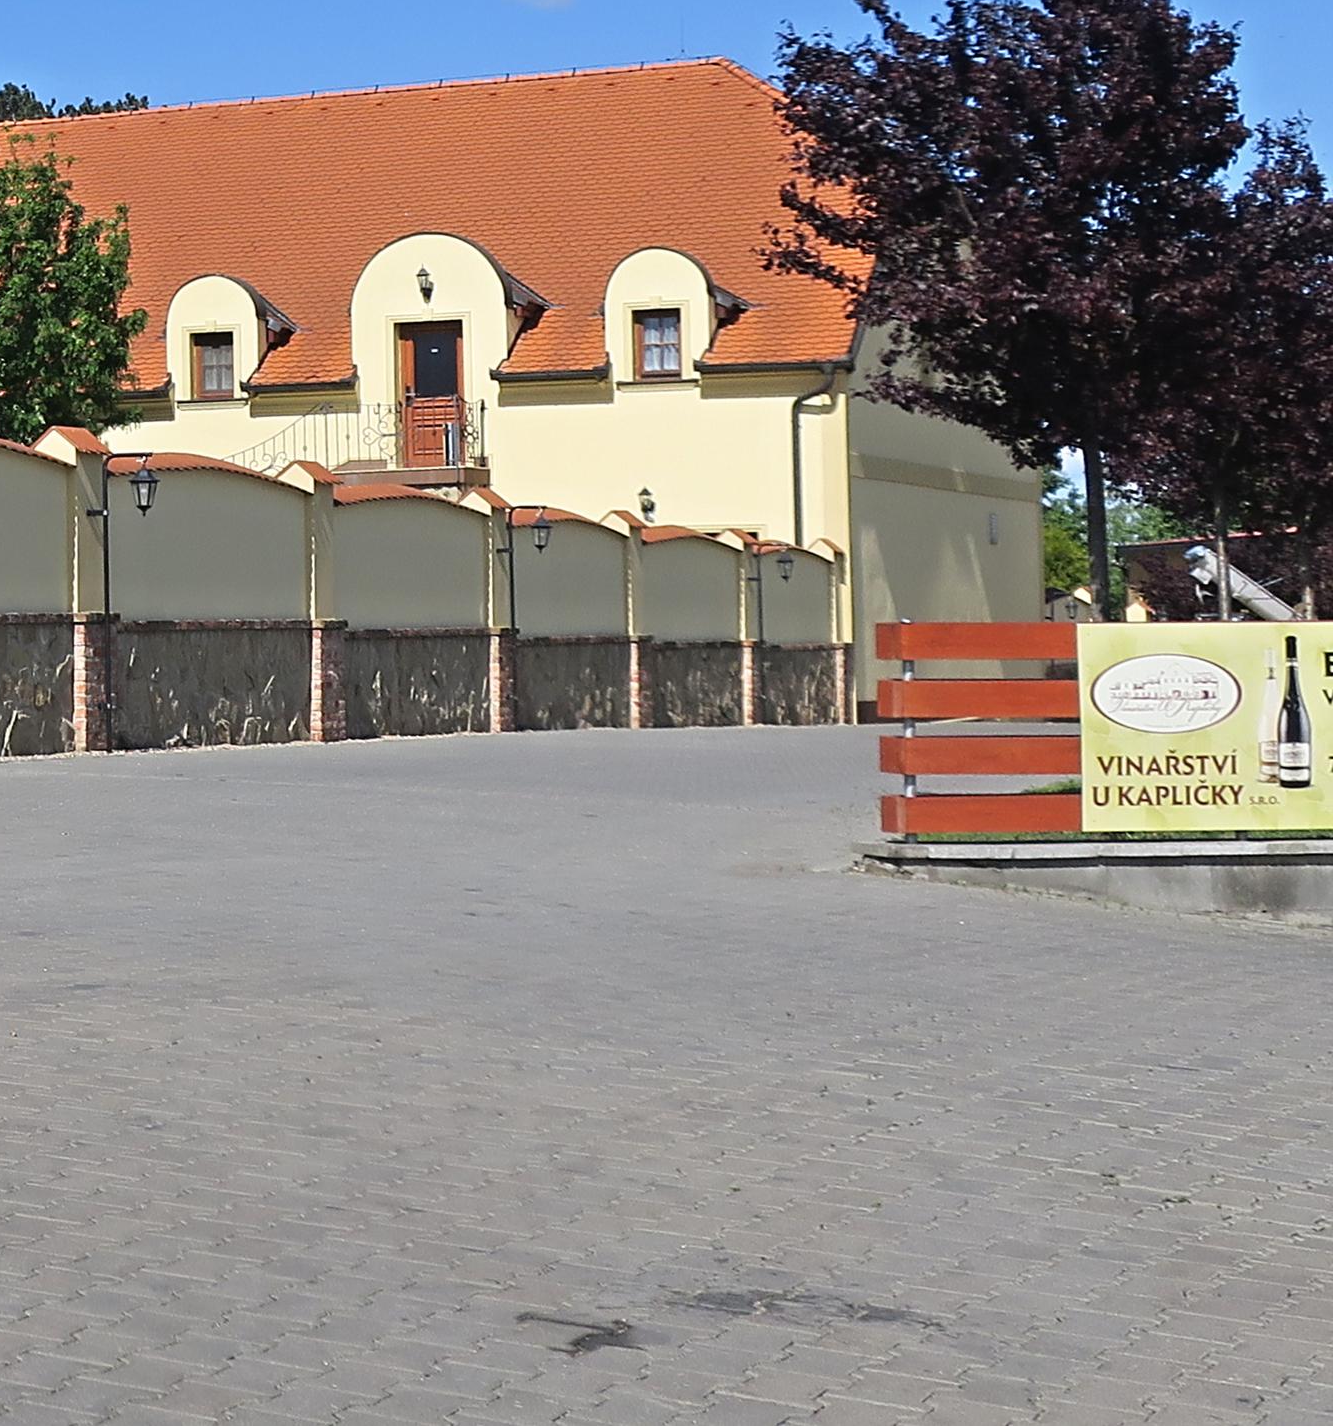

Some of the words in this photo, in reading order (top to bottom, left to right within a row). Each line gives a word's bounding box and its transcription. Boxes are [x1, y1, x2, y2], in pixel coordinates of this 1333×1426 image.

[1097, 749, 1237, 776] VINAŘSTVÍ
[1092, 785, 1110, 807] U
[1118, 778, 1244, 807] KAPLIČKY
